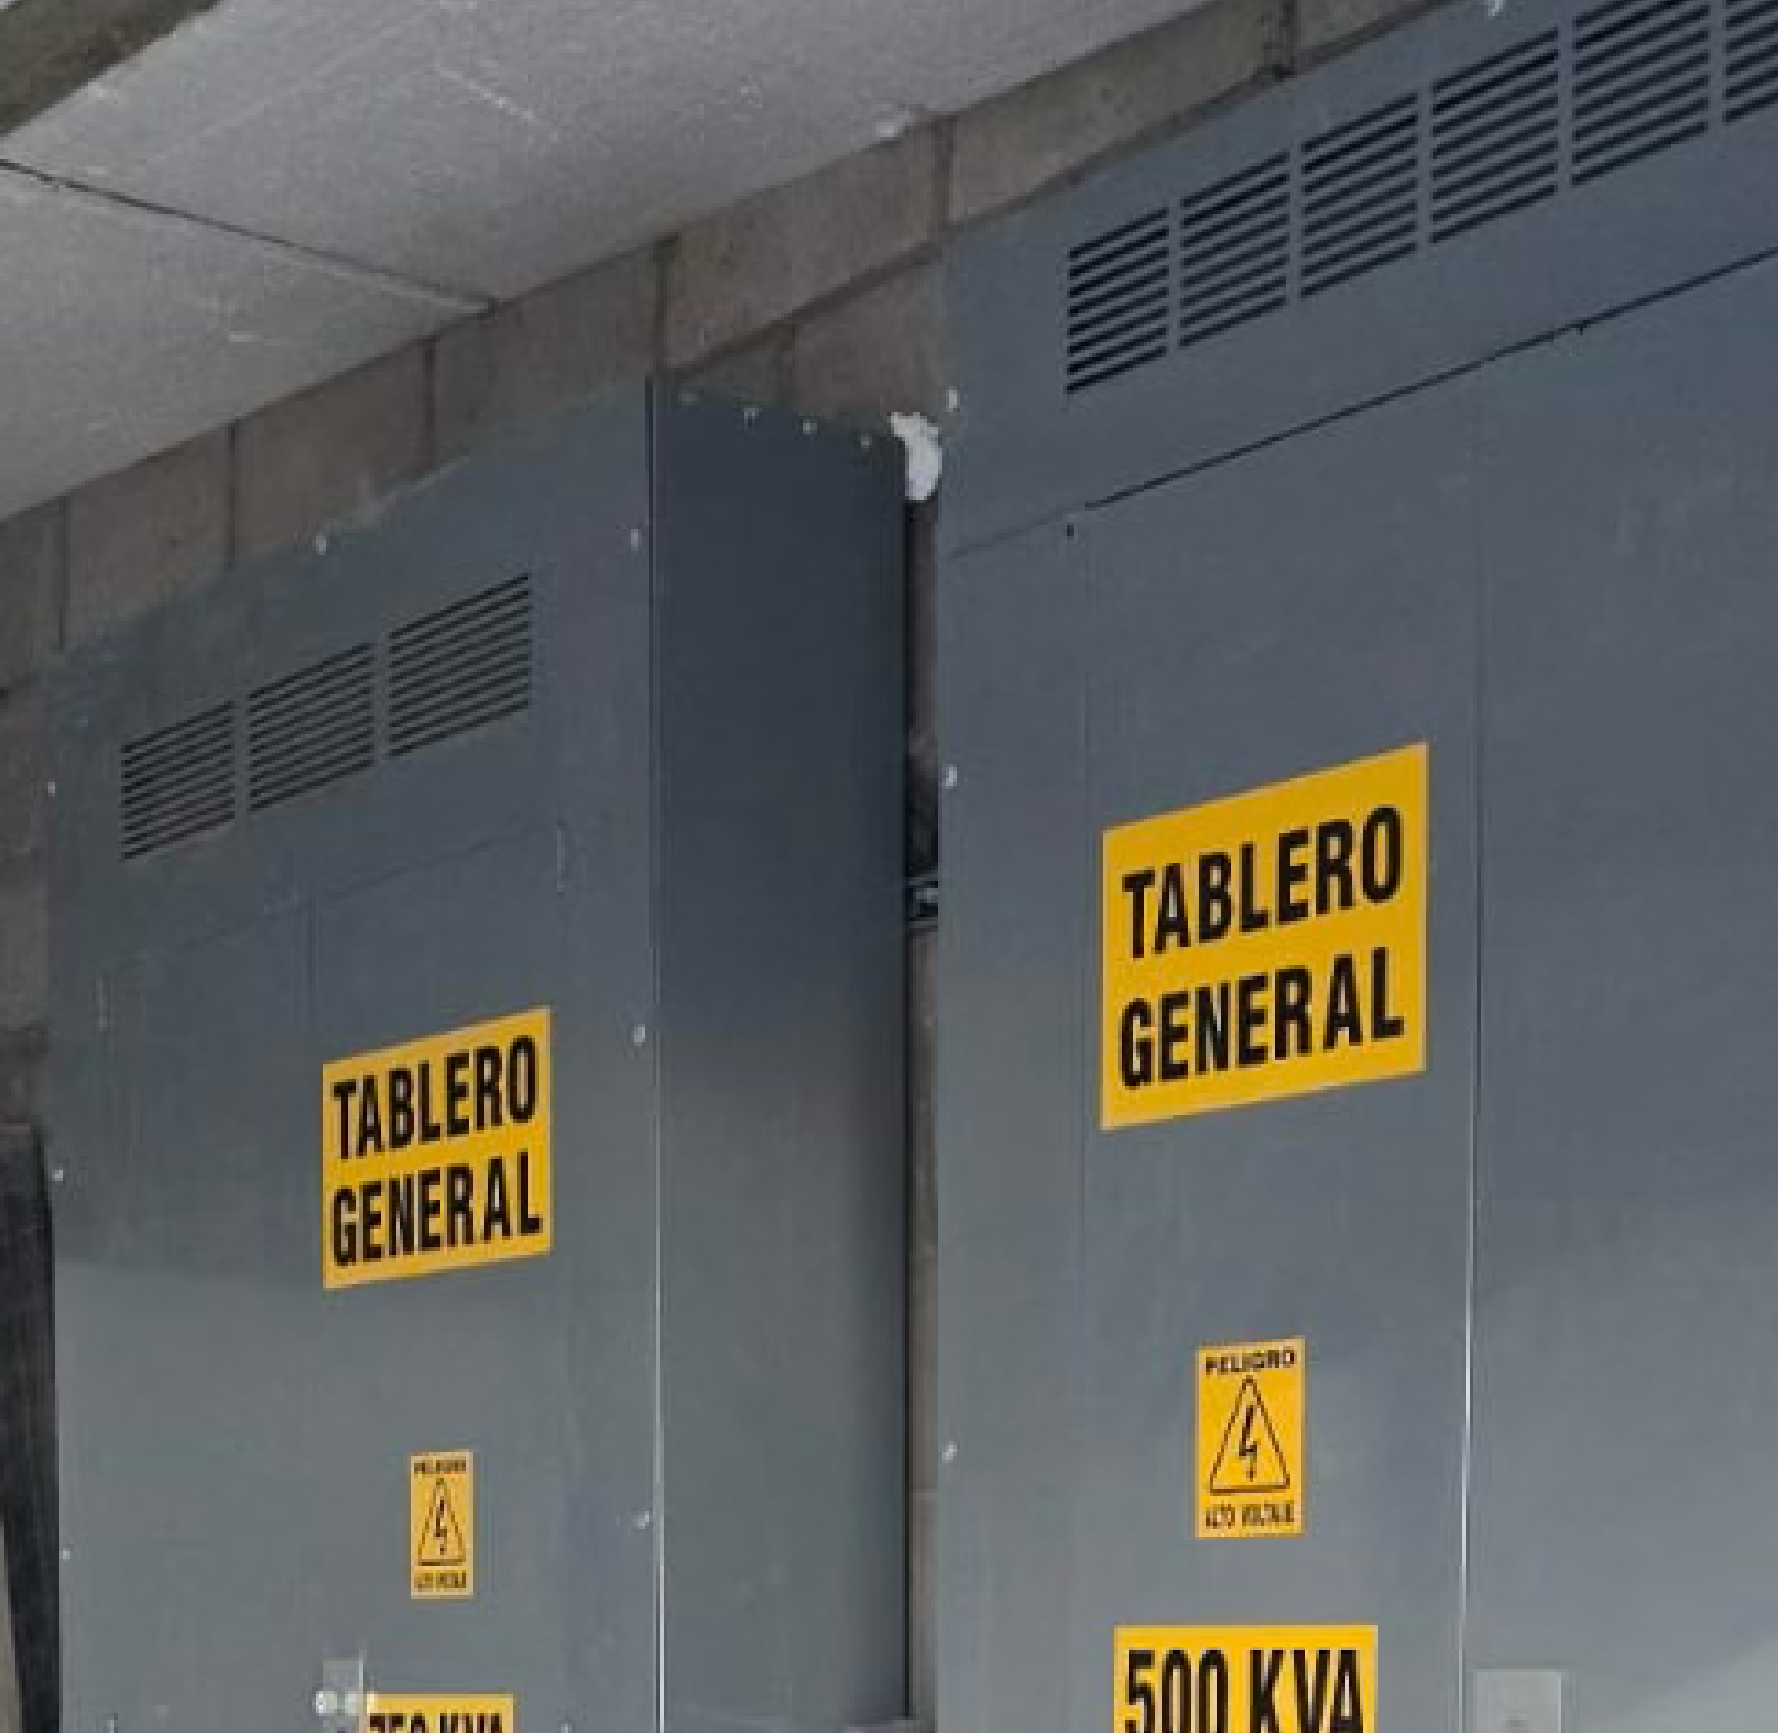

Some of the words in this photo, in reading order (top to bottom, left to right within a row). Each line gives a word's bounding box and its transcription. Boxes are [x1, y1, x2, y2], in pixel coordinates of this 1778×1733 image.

[1121, 805, 1402, 959] TABLERO
[1121, 946, 1405, 1090] GENERAL
[333, 1034, 537, 1160] TABLERO
[333, 1150, 543, 1268] GENERAL
